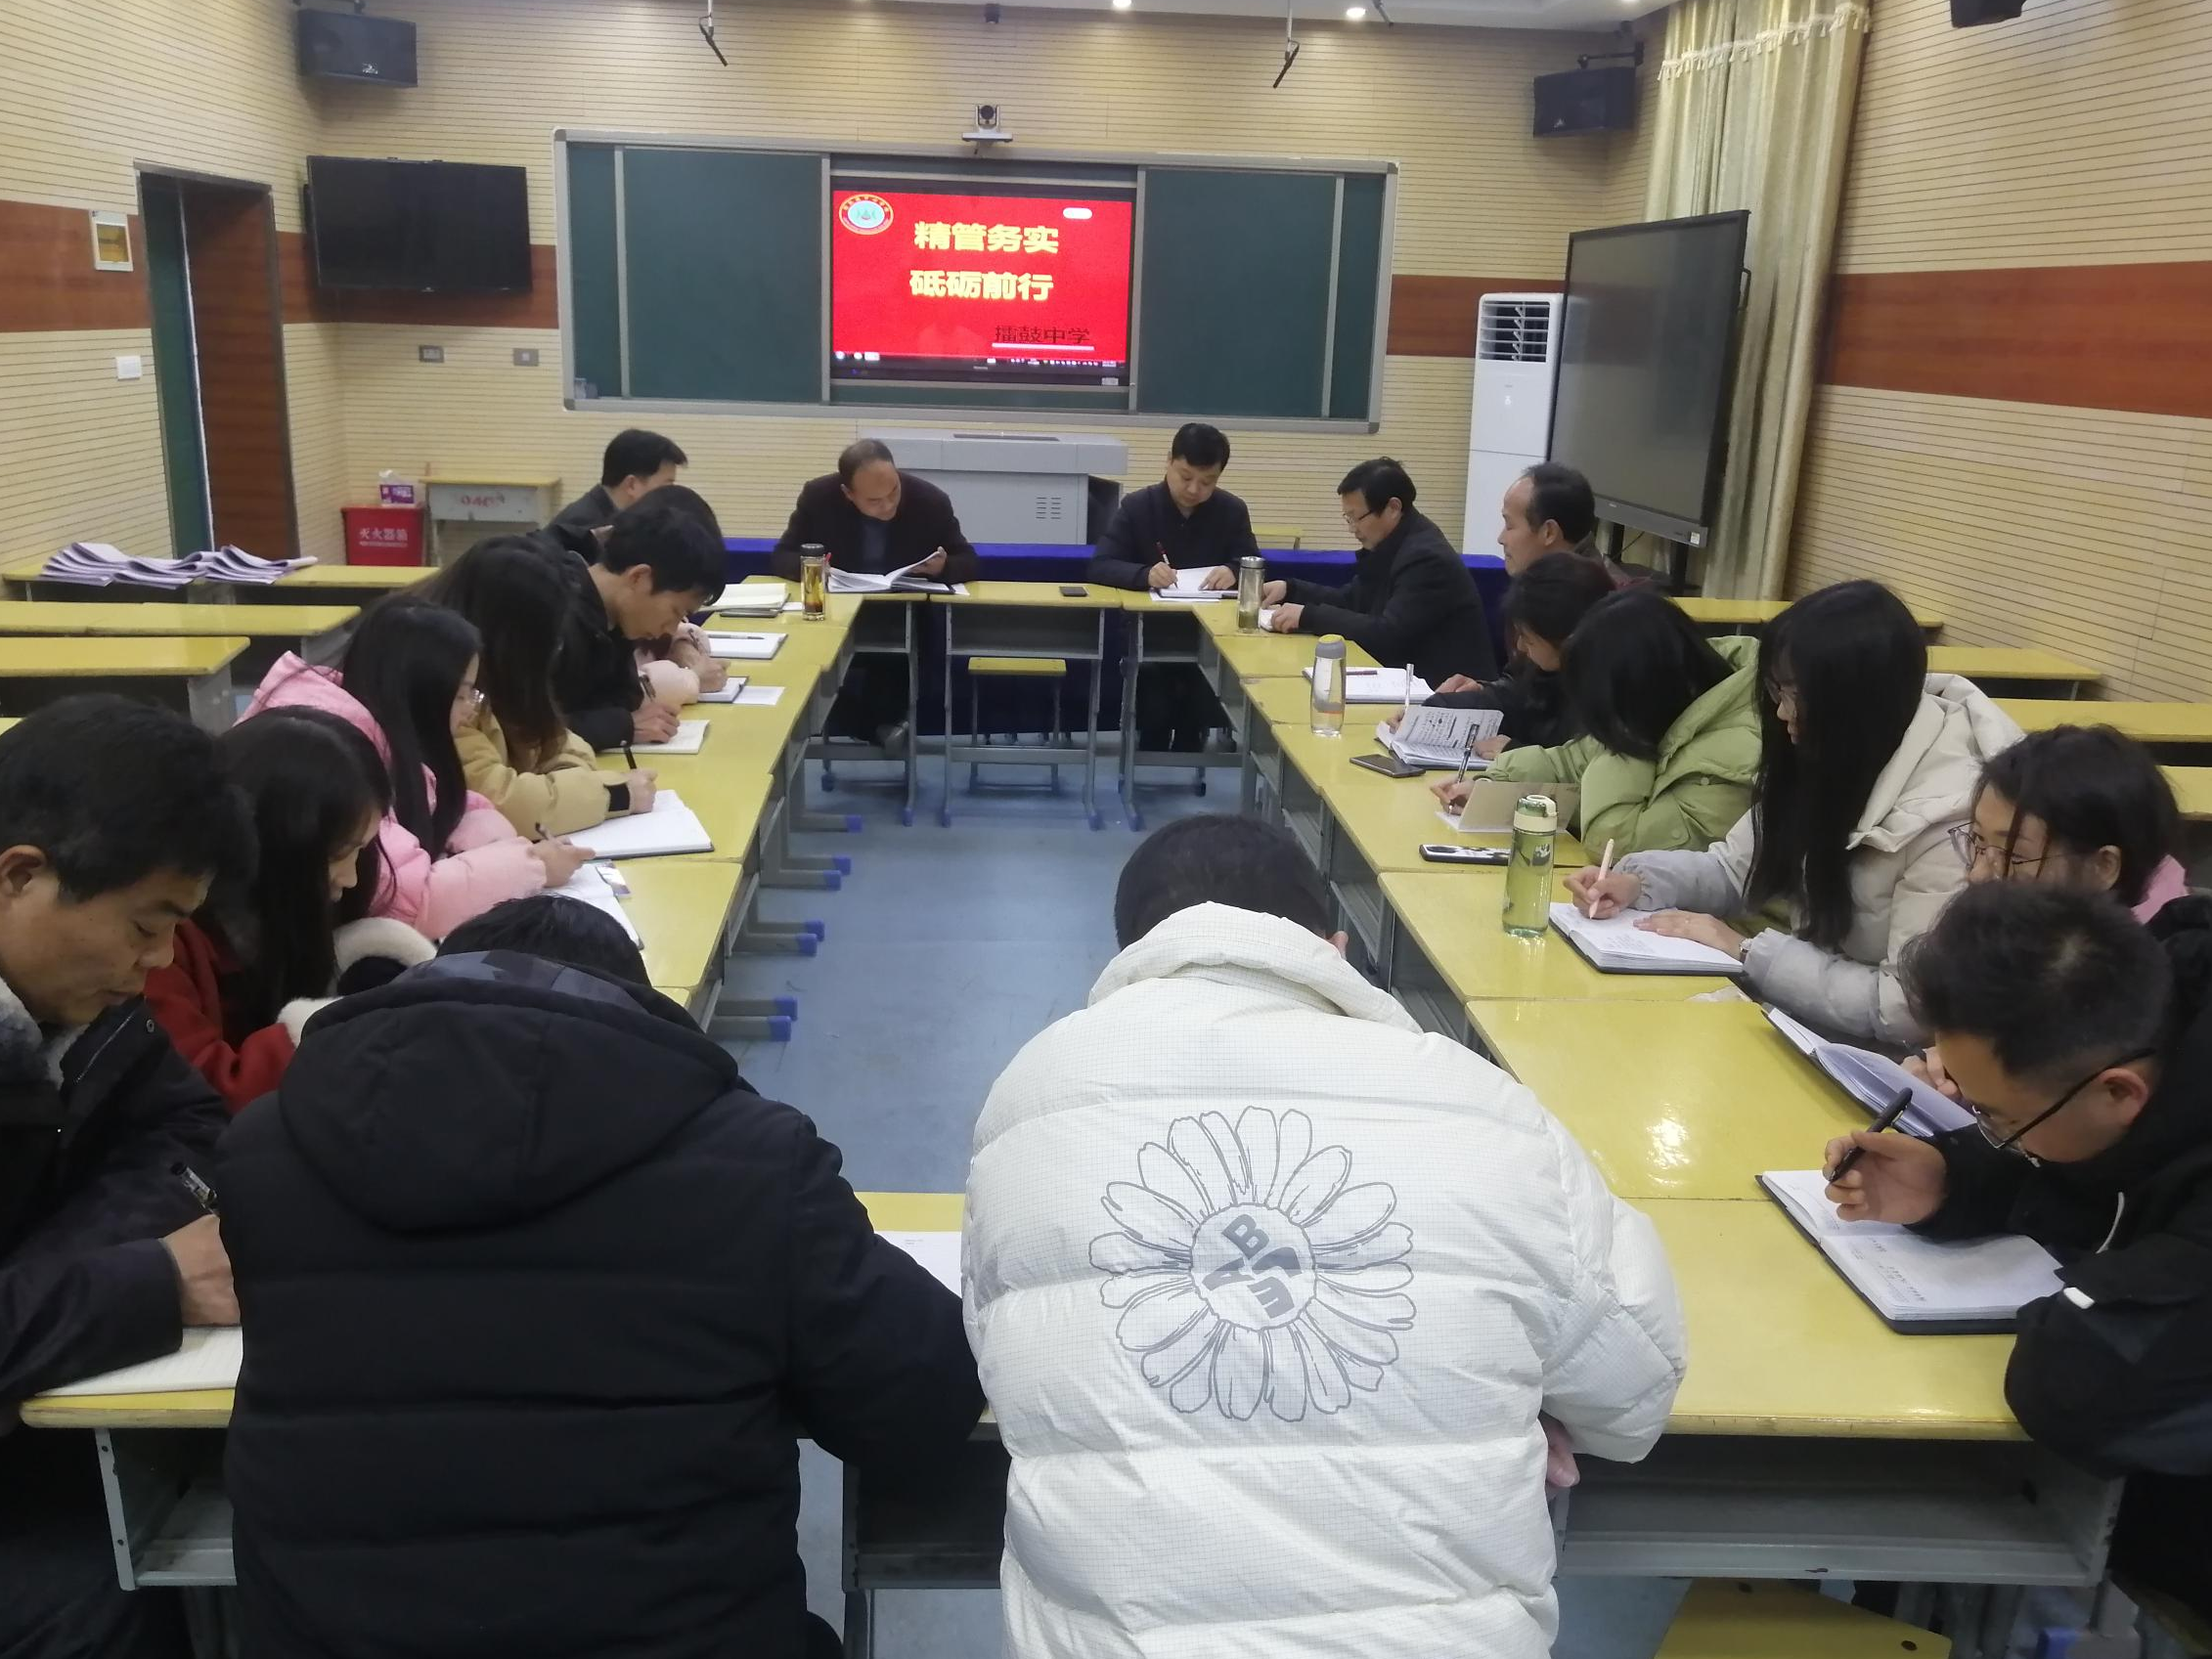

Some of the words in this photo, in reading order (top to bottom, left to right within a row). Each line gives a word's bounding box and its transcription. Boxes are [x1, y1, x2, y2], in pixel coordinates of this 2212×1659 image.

[913, 221, 1059, 254] 精管务实
[909, 269, 1054, 301] 砥砺前行
[995, 325, 1090, 343] 擂鼓中学
